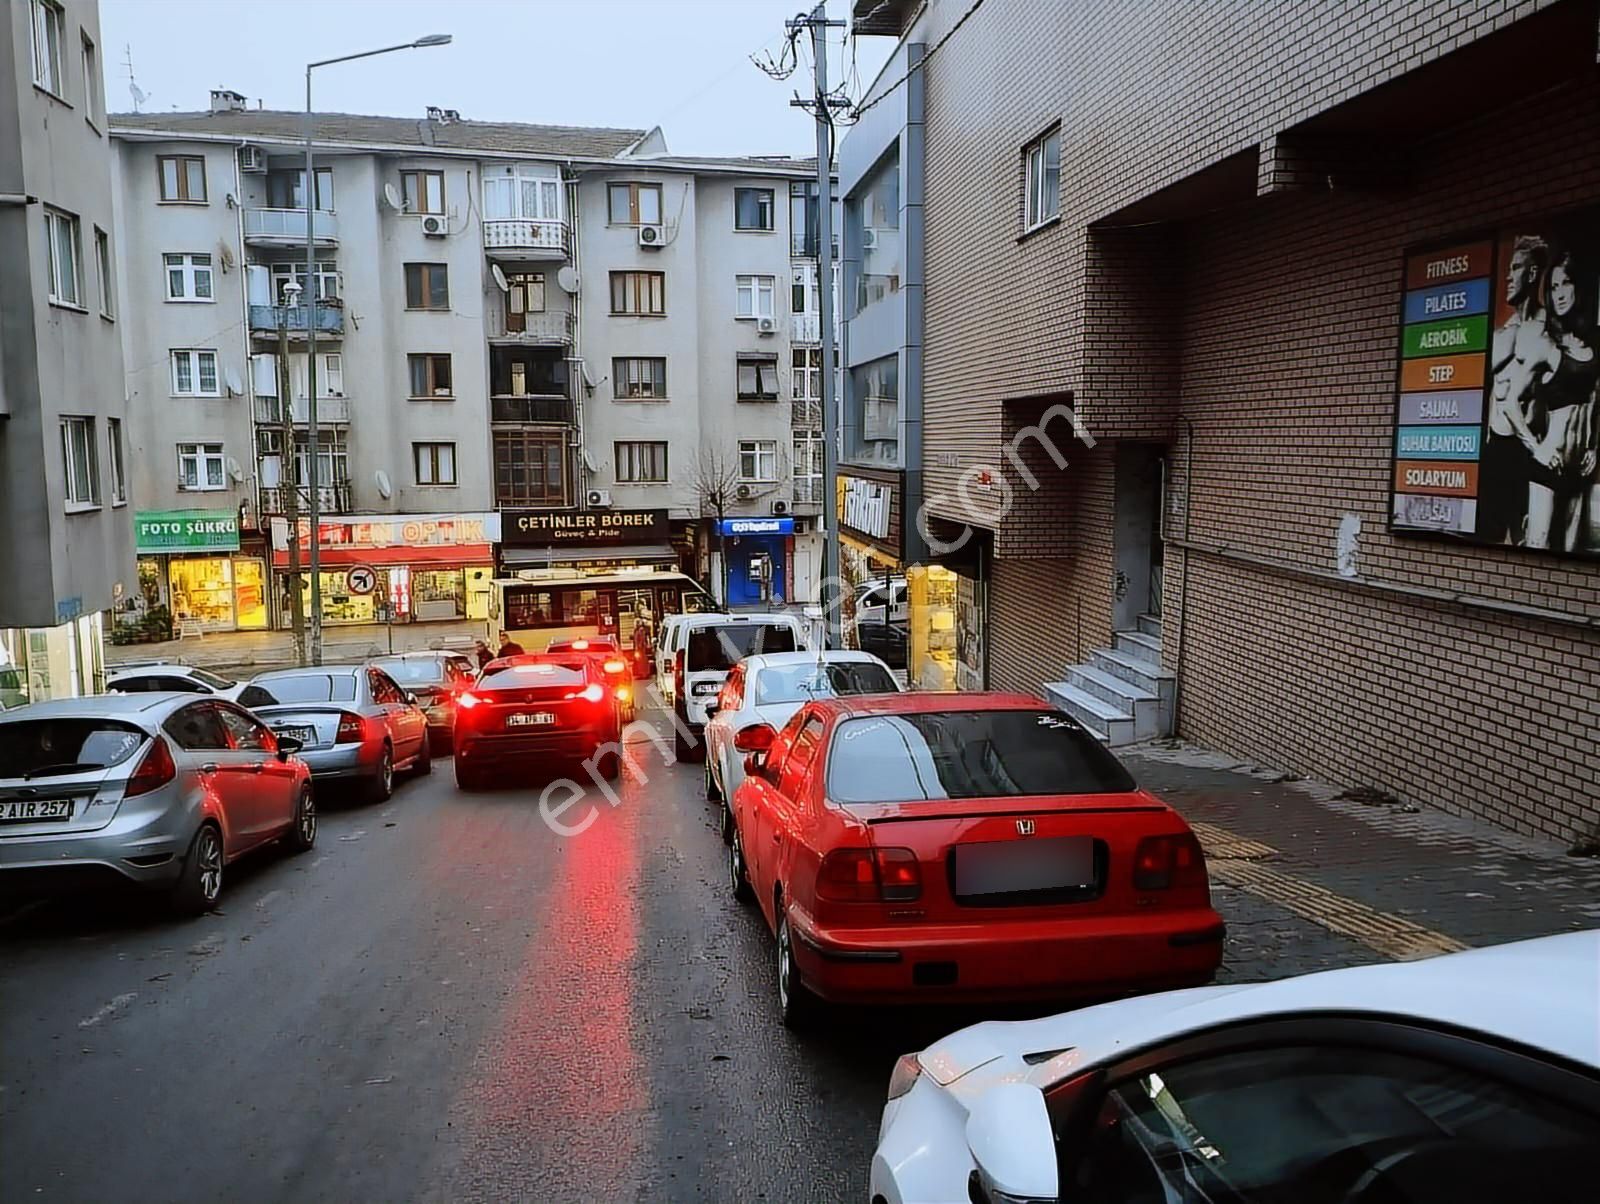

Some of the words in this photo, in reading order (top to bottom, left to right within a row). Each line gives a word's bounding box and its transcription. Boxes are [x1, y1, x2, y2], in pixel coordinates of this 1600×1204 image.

[1426, 255, 1469, 279] FITNESS
[1424, 291, 1467, 314] PILATES
[1419, 322, 1468, 349] AEROBİK
[1428, 364, 1454, 382] STEP
[1419, 399, 1459, 419] SAUNA
[1405, 468, 1466, 489] SOLARYUM
[141, 523, 181, 536] FOTO
[518, 513, 596, 532] ÇETİNLER
[602, 512, 654, 527] BÖREK
[8, 802, 37, 818] AIR
[40, 800, 68, 816] 257
